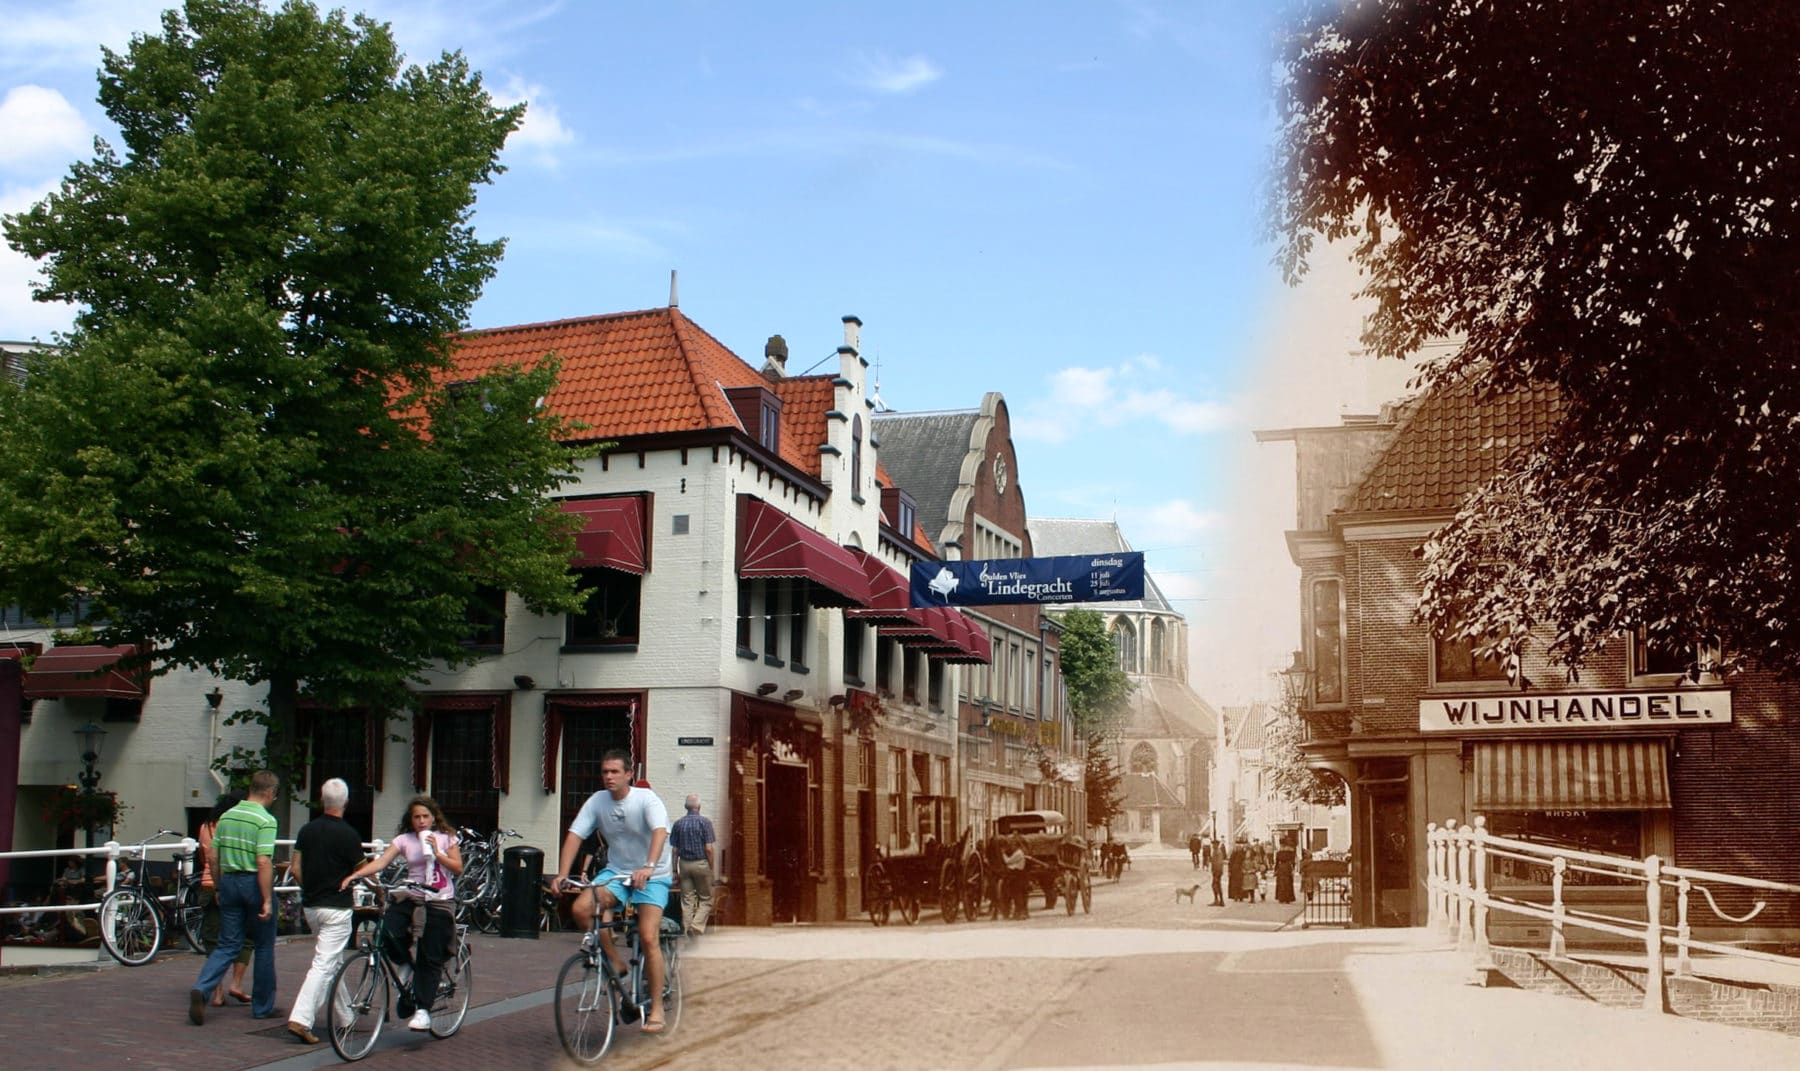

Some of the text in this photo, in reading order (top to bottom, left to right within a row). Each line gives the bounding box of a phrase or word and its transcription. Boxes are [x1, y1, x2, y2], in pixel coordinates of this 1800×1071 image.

[1091, 557, 1123, 567] dinsdag
[1009, 571, 1027, 580] Vlies
[1091, 571, 1110, 580] 11 juli
[988, 577, 1073, 599] Lindegracht
[1037, 593, 1073, 601] Concerten
[1442, 695, 1713, 725] WIJNHANDEL.
